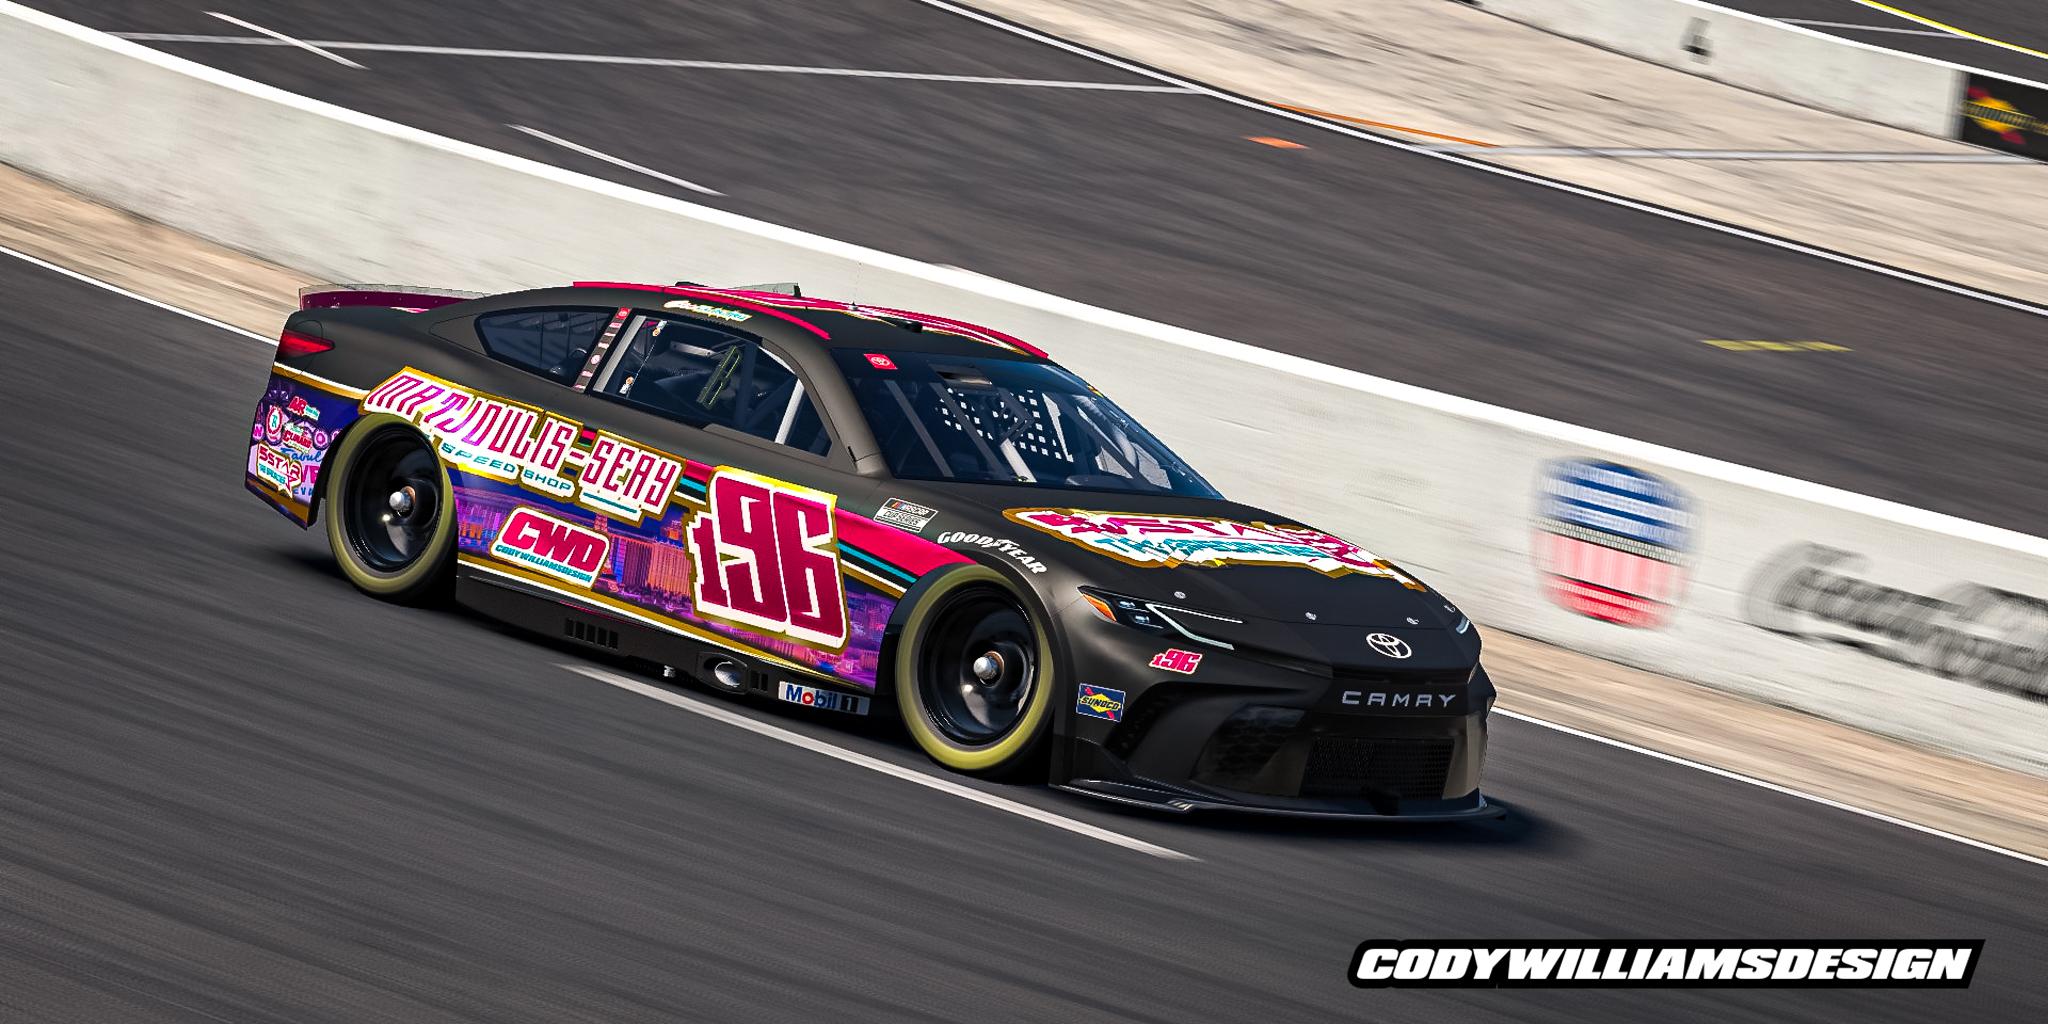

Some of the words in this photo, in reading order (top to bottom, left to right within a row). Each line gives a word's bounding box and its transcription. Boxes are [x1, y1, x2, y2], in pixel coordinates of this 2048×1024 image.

[441, 442, 516, 472] SPEED
[524, 470, 572, 490] SHOP
[502, 512, 606, 573] CWD
[937, 532, 1048, 574] GOODYEAR
[495, 544, 593, 583] CODYWILLIAMSDESIGN
[785, 685, 837, 709] Mobil
[1081, 697, 1120, 711] SUNOCO
